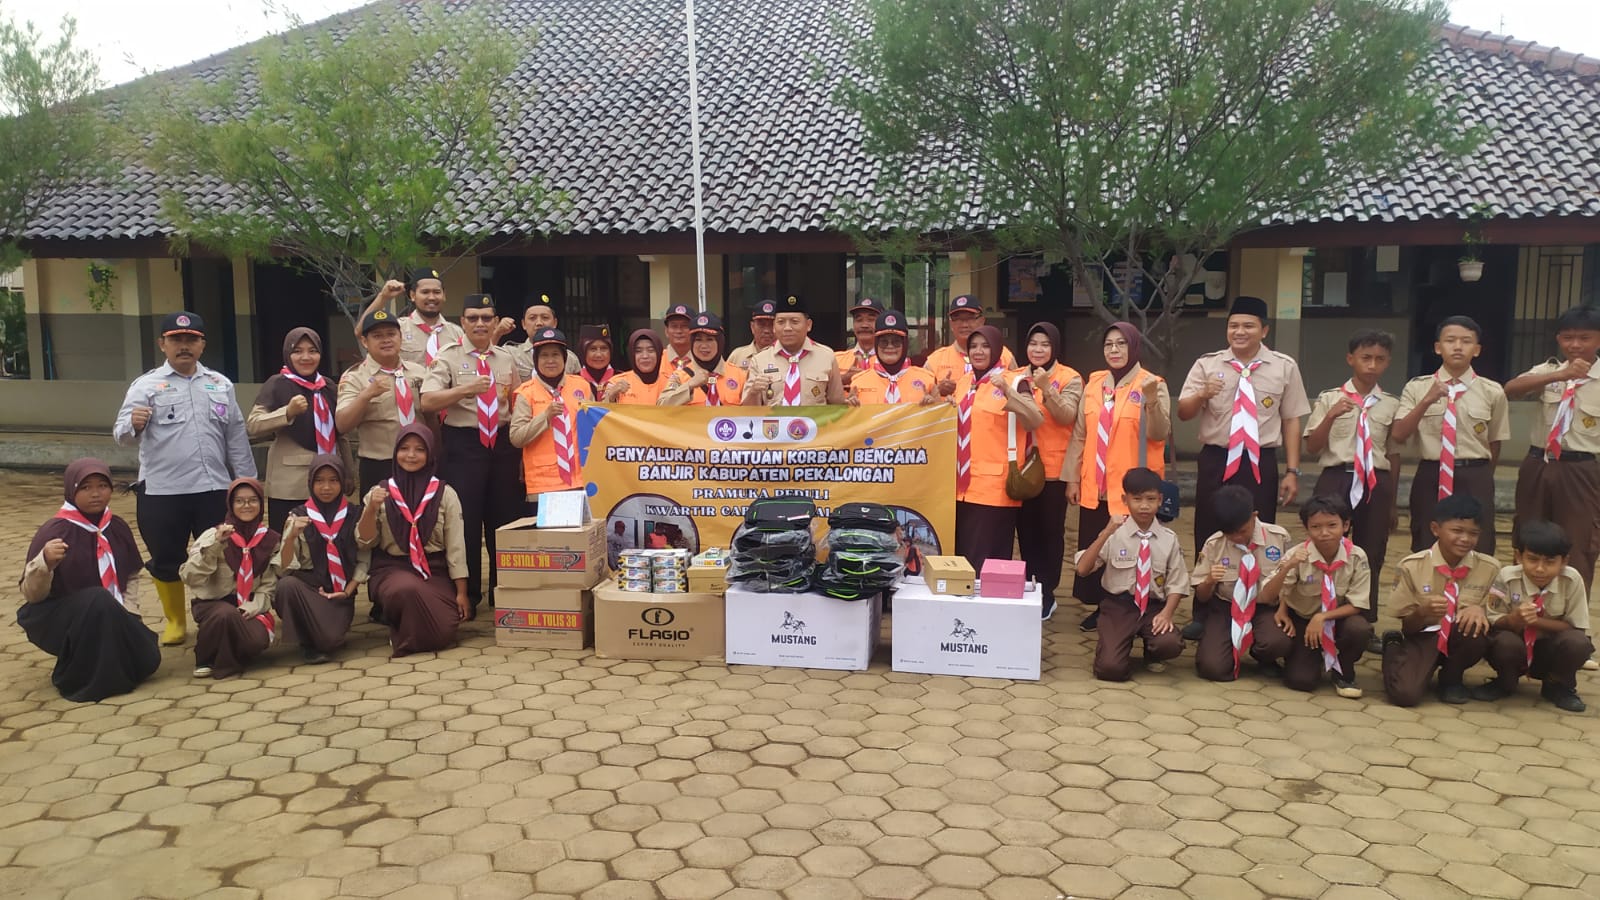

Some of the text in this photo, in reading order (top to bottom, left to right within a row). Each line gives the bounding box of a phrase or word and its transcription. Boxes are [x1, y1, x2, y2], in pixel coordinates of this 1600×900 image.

[606, 446, 928, 466] PENYALURAN BANTUAN KORBAN BENCANA
[638, 465, 894, 483] BANJIR KABUPATEN PEKALONGAN
[693, 488, 769, 499] PRAMUKA
[645, 504, 716, 517] KWARTIR
[501, 554, 511, 567] 38
[512, 554, 535, 568] TULIS
[542, 614, 565, 628] TULIS
[566, 615, 577, 628] 38
[628, 628, 690, 641] FLAGIO
[771, 634, 817, 646] MUSTANG
[940, 642, 988, 655] MUSTANG
